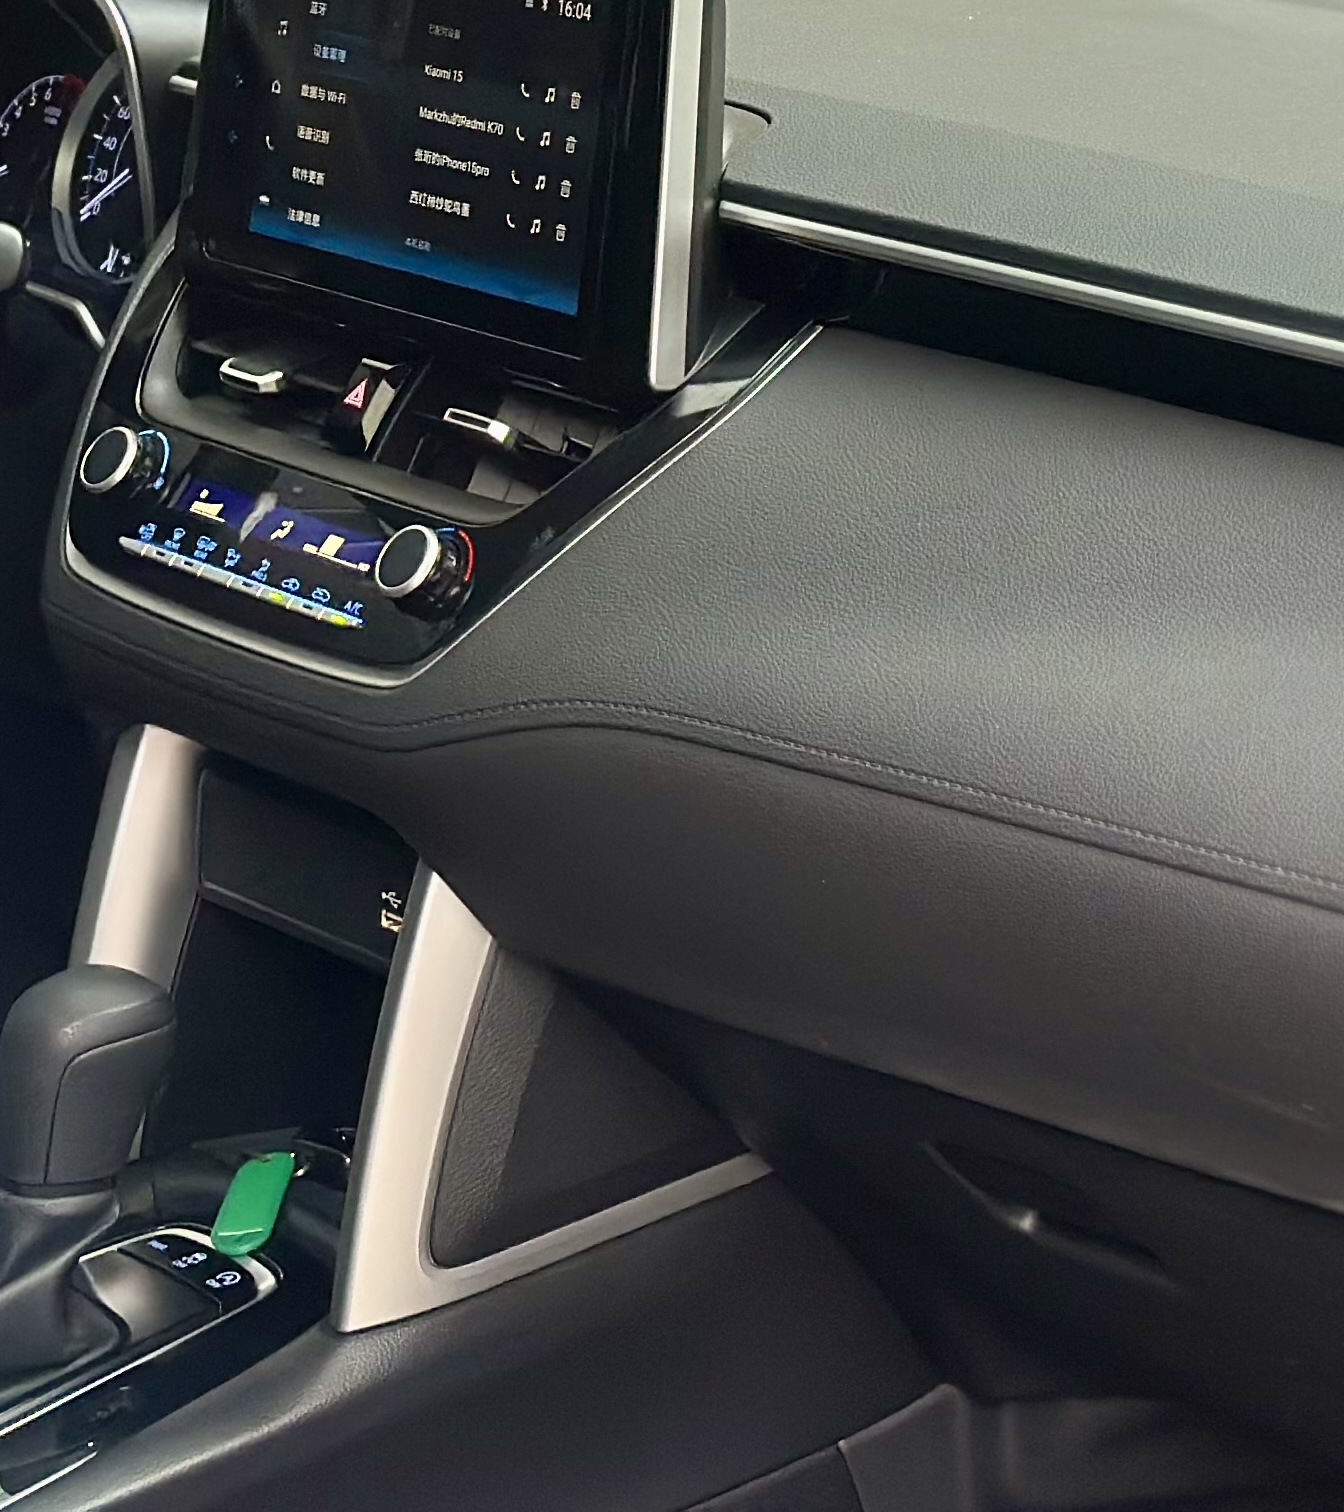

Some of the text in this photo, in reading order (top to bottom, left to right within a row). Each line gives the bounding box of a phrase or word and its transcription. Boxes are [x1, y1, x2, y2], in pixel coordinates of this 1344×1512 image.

[309, 0, 328, 16] 蓝牙
[557, 0, 592, 21] 16:04
[424, 63, 464, 83] Xiaomi 15
[486, 120, 504, 136] K70
[102, 136, 117, 151] 40
[94, 167, 108, 183] 20
[292, 166, 326, 186] 软件更新
[287, 207, 321, 227] 法律信息
[343, 600, 364, 616] A/C
